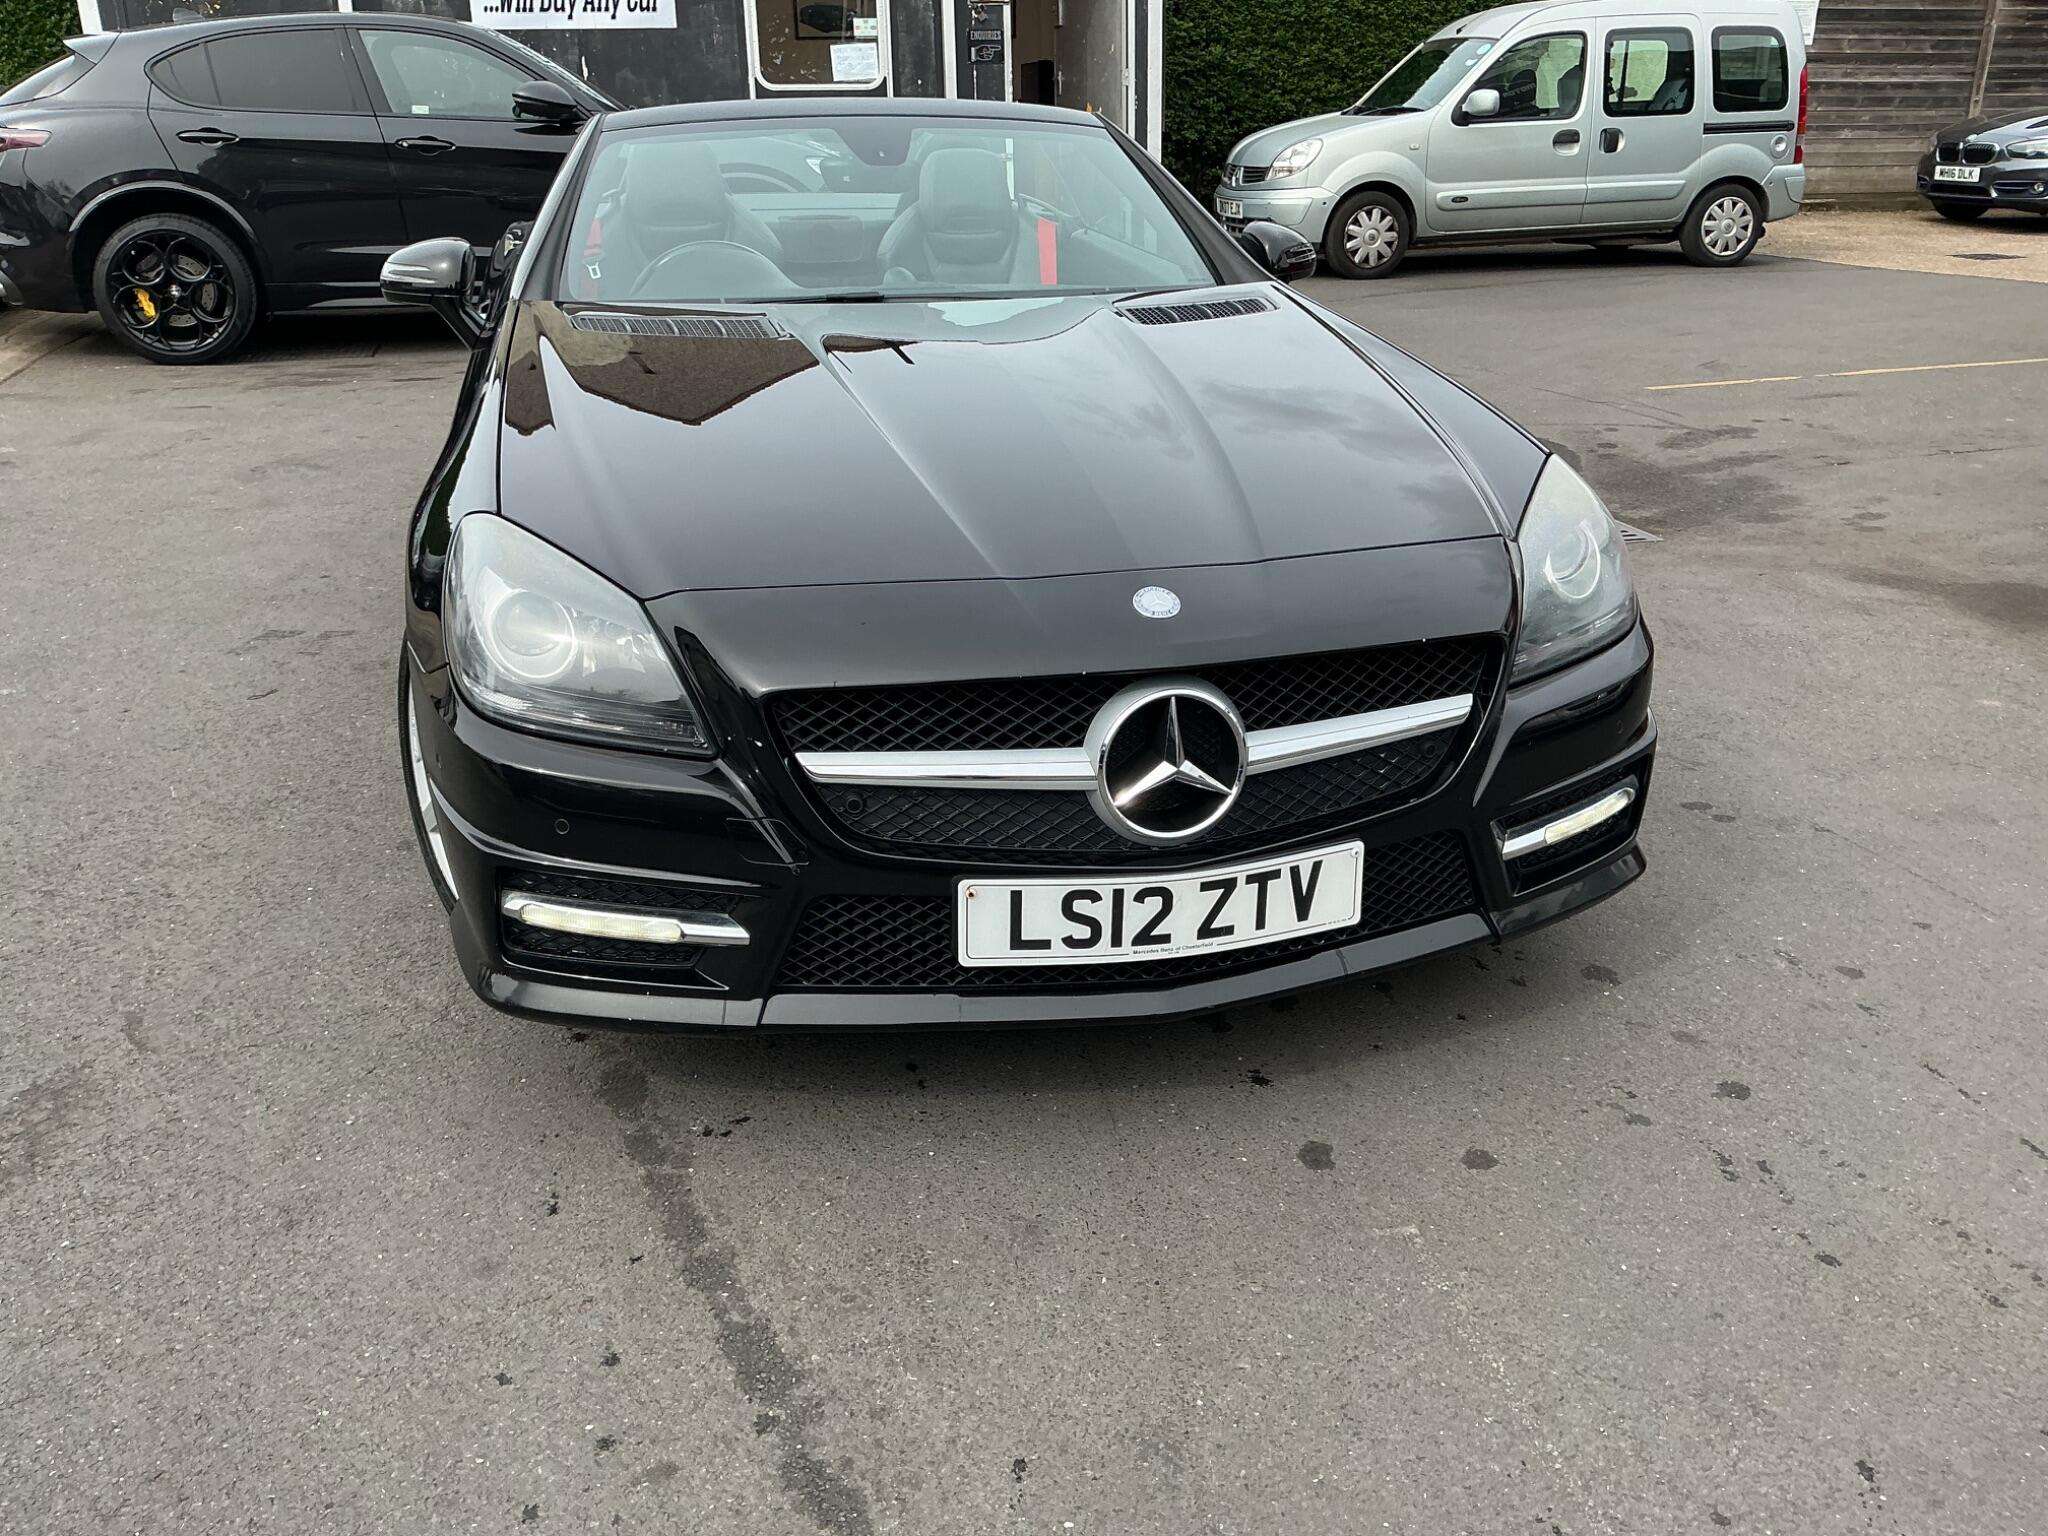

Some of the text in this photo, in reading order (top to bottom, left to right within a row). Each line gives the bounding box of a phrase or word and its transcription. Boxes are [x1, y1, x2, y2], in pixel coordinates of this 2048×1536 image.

[970, 30, 1002, 41] ENQUIRIES
[1958, 168, 1975, 180] DLK
[1009, 860, 1323, 951] LS12 ZTV
